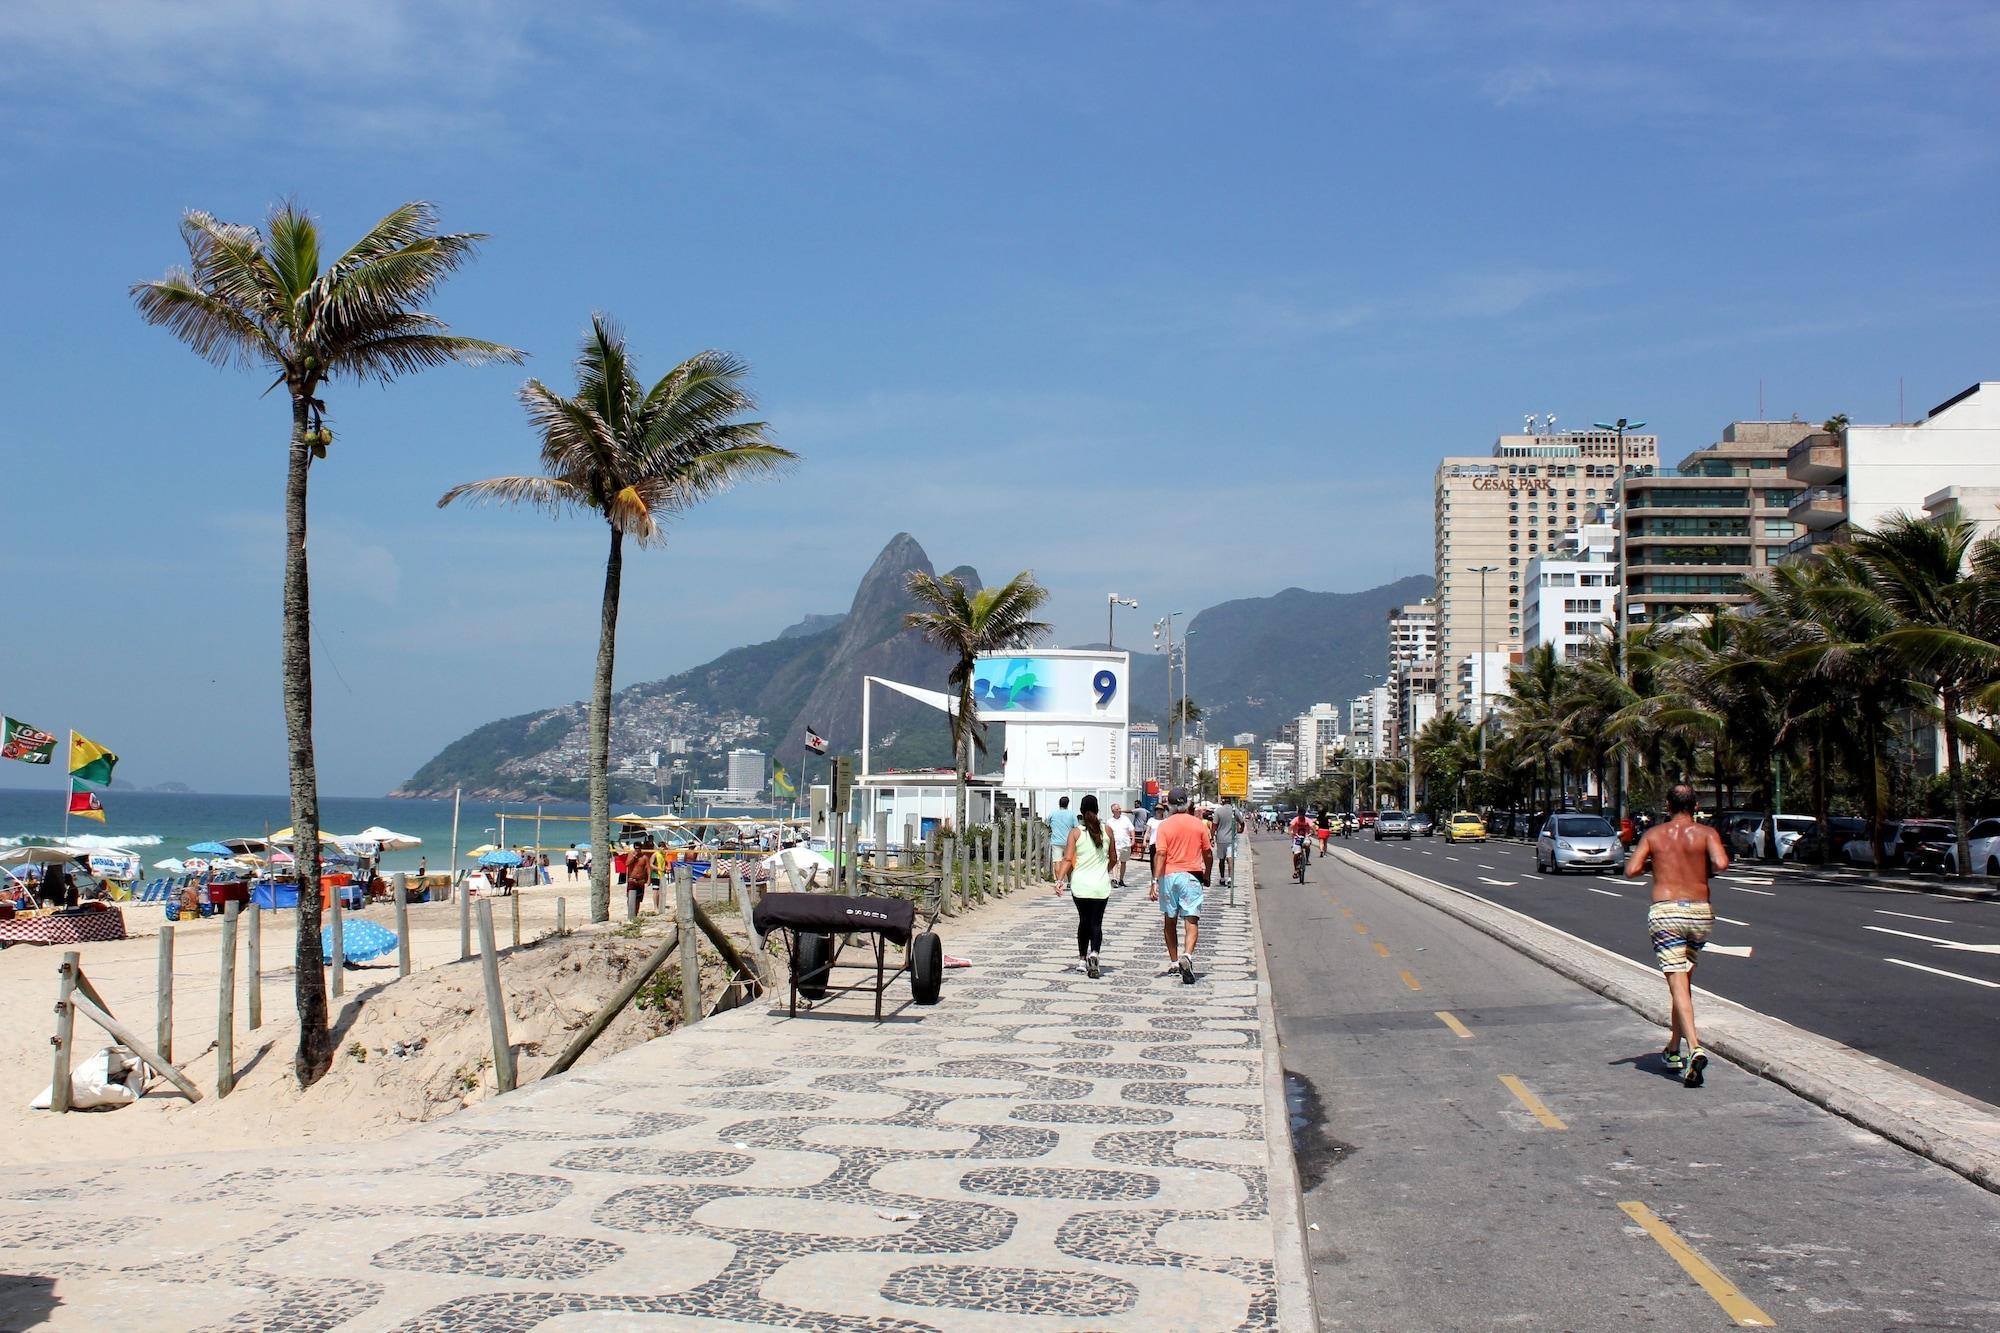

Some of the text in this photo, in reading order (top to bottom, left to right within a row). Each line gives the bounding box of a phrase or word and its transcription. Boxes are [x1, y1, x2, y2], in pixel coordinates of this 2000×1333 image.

[1518, 478, 1552, 490] PARK
[1093, 670, 1117, 707] 9
[846, 908, 888, 920] RUSSO
